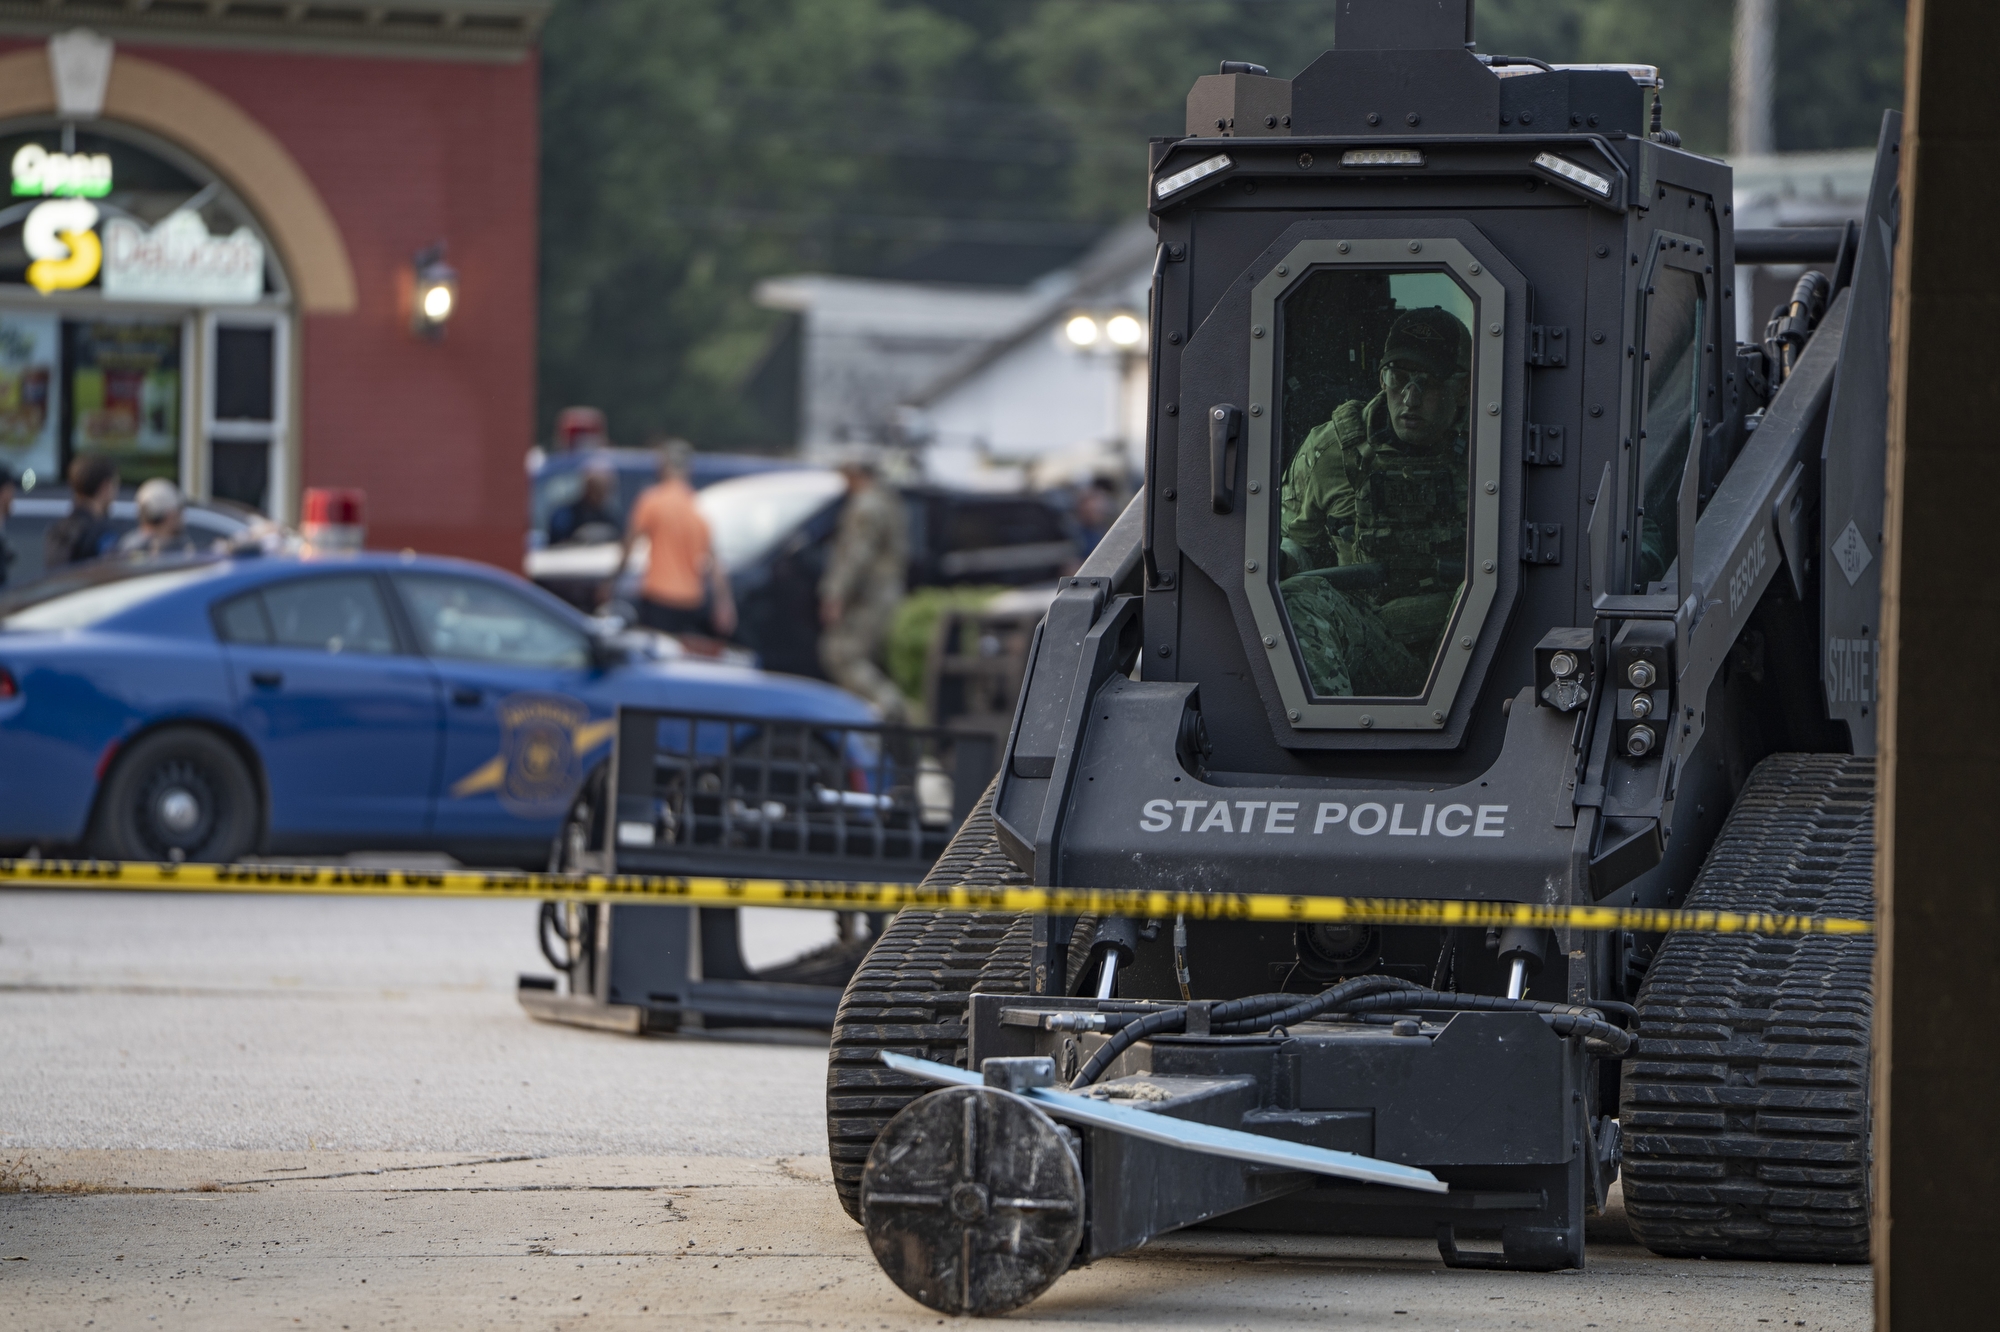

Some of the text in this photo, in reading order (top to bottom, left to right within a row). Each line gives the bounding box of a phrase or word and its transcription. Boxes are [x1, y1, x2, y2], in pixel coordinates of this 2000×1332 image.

[1729, 527, 1766, 617] RESCUE
[1843, 549, 1861, 573] TEAM
[1828, 636, 1869, 703] STATE
[1140, 799, 1508, 837] STATE POLICE
